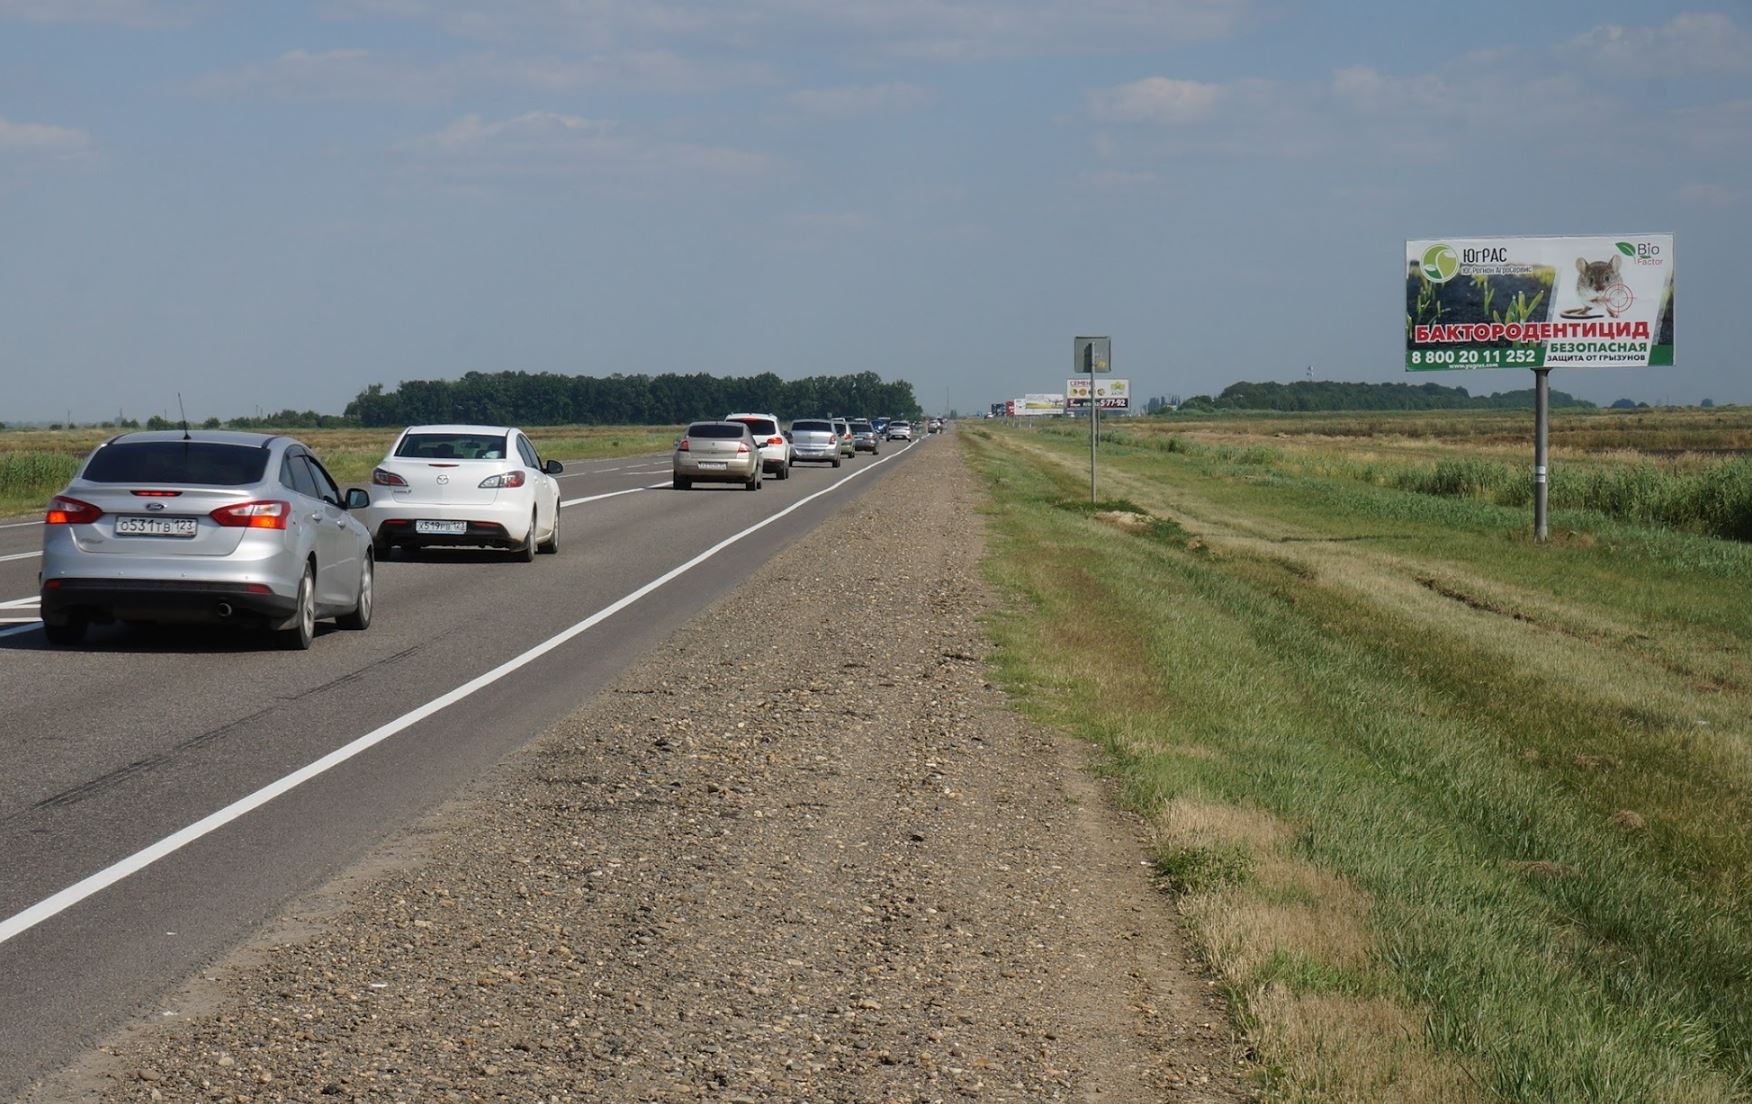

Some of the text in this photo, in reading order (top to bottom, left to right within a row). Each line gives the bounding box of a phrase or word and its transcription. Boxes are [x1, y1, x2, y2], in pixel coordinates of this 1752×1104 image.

[1463, 248, 1507, 263] ЮгРАС
[1637, 243, 1660, 255] Bio
[1415, 321, 1650, 341] БАКТОРОДЕНТИЦИД
[1550, 342, 1647, 353] БЕЗОПАСНАЯ
[1411, 350, 1536, 364] 8 800 20 11 252
